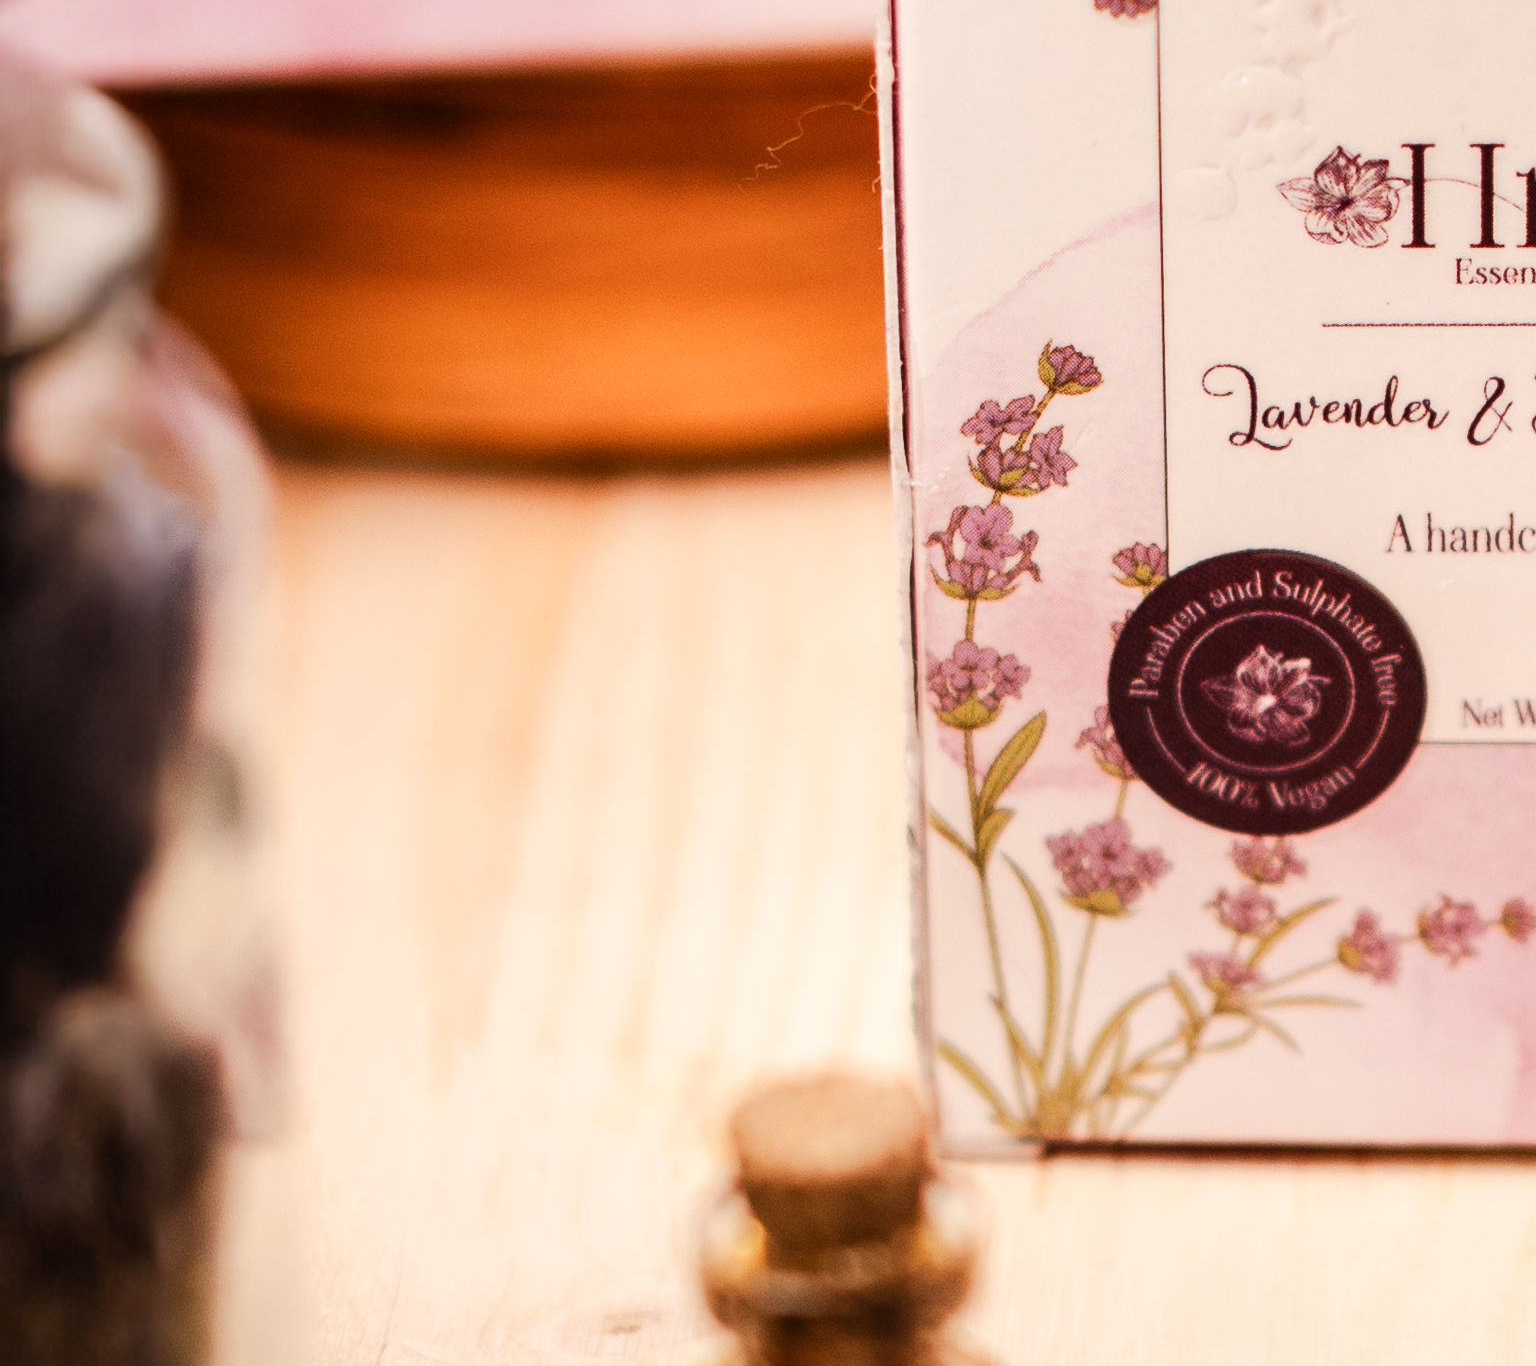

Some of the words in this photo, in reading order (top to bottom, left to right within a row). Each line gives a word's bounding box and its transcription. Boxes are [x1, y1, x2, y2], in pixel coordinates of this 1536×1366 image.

[1200, 363, 1450, 451] Lavender
[1466, 375, 1514, 447] &
[1385, 513, 1416, 554] A
[1128, 599, 1207, 697] Paraben
[1208, 570, 1263, 610] and
[1272, 570, 1384, 653] Sulphate
[1462, 698, 1504, 728] Net
[1184, 761, 1260, 809] 100%
[1269, 765, 1358, 811] Vegan
